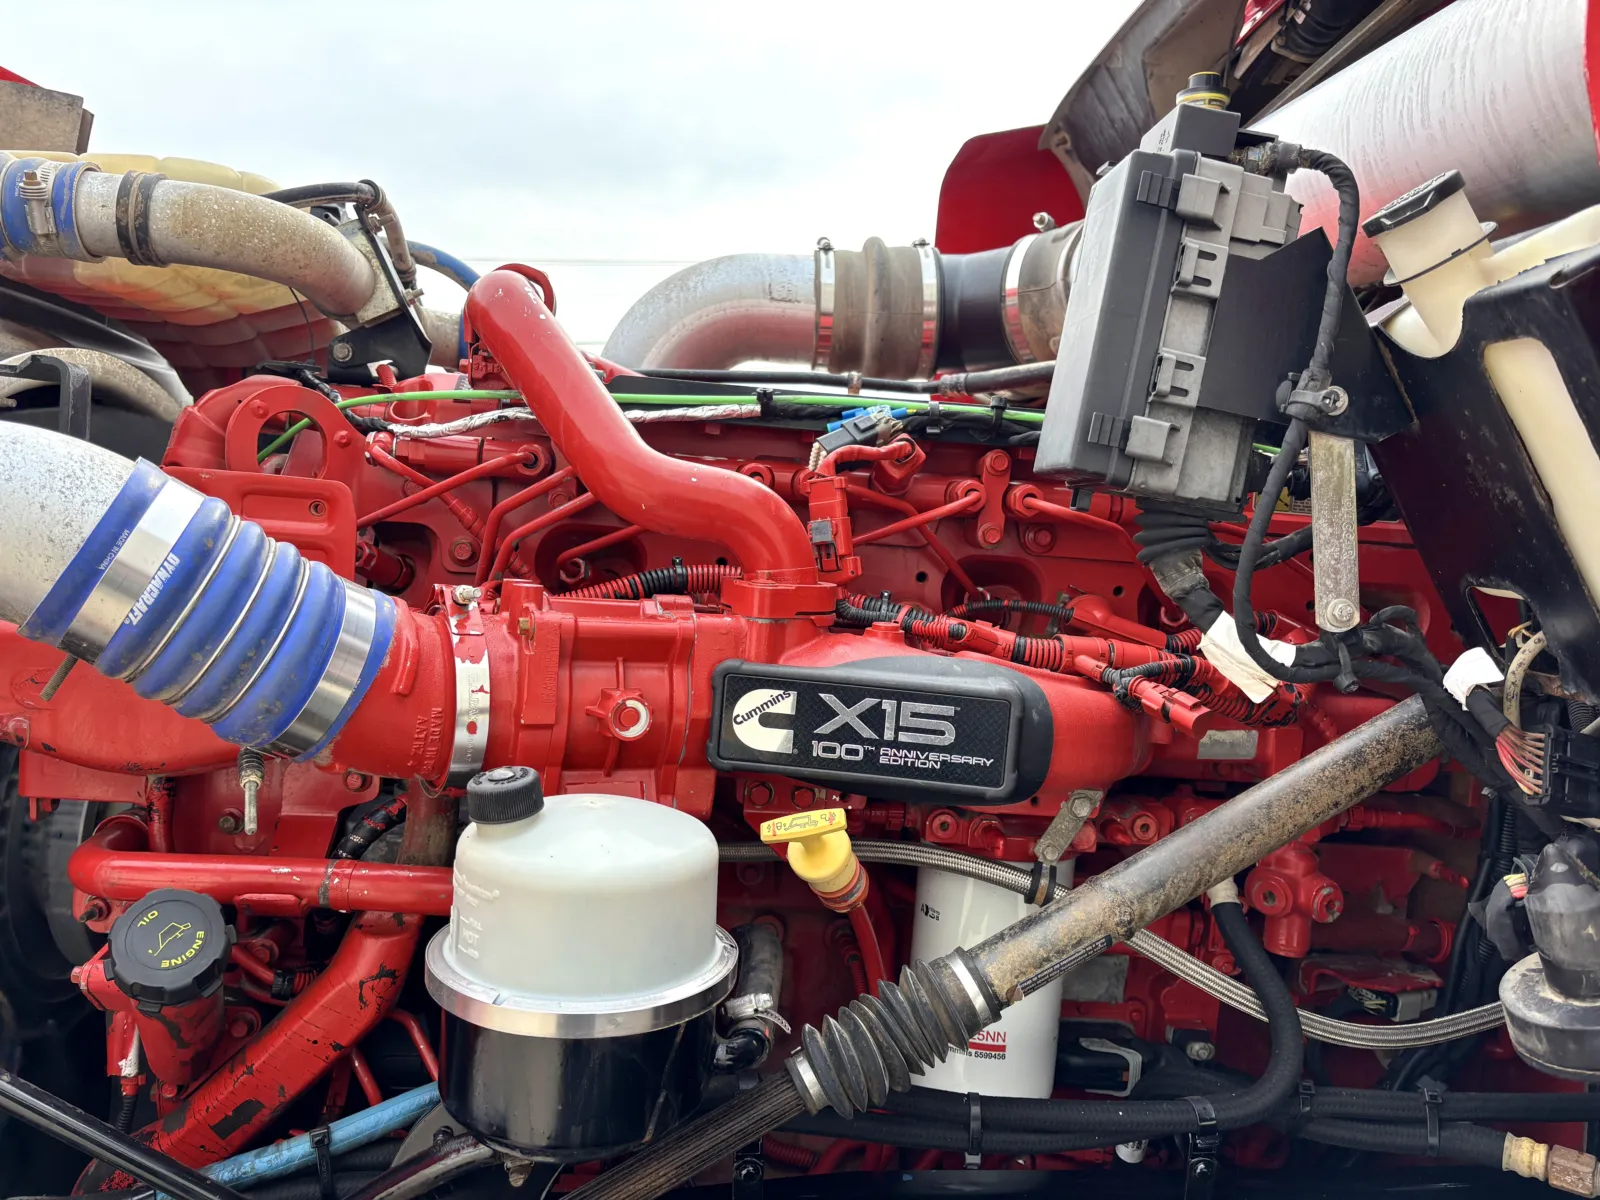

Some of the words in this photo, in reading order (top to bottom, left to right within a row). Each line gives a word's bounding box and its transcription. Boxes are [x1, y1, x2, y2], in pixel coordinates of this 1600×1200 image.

[116, 529, 130, 547] MADE
[111, 546, 119, 554] IN
[127, 552, 180, 626] DYNACRAFT
[733, 690, 791, 725] Cummins
[428, 707, 443, 744] MADE
[813, 693, 956, 746] X15
[879, 756, 941, 769] EDITION
[880, 747, 994, 767] ANNIVERSARY
[137, 909, 159, 927] OIL
[160, 930, 205, 968] ENGINE
[974, 1050, 1006, 1060] 5599456
